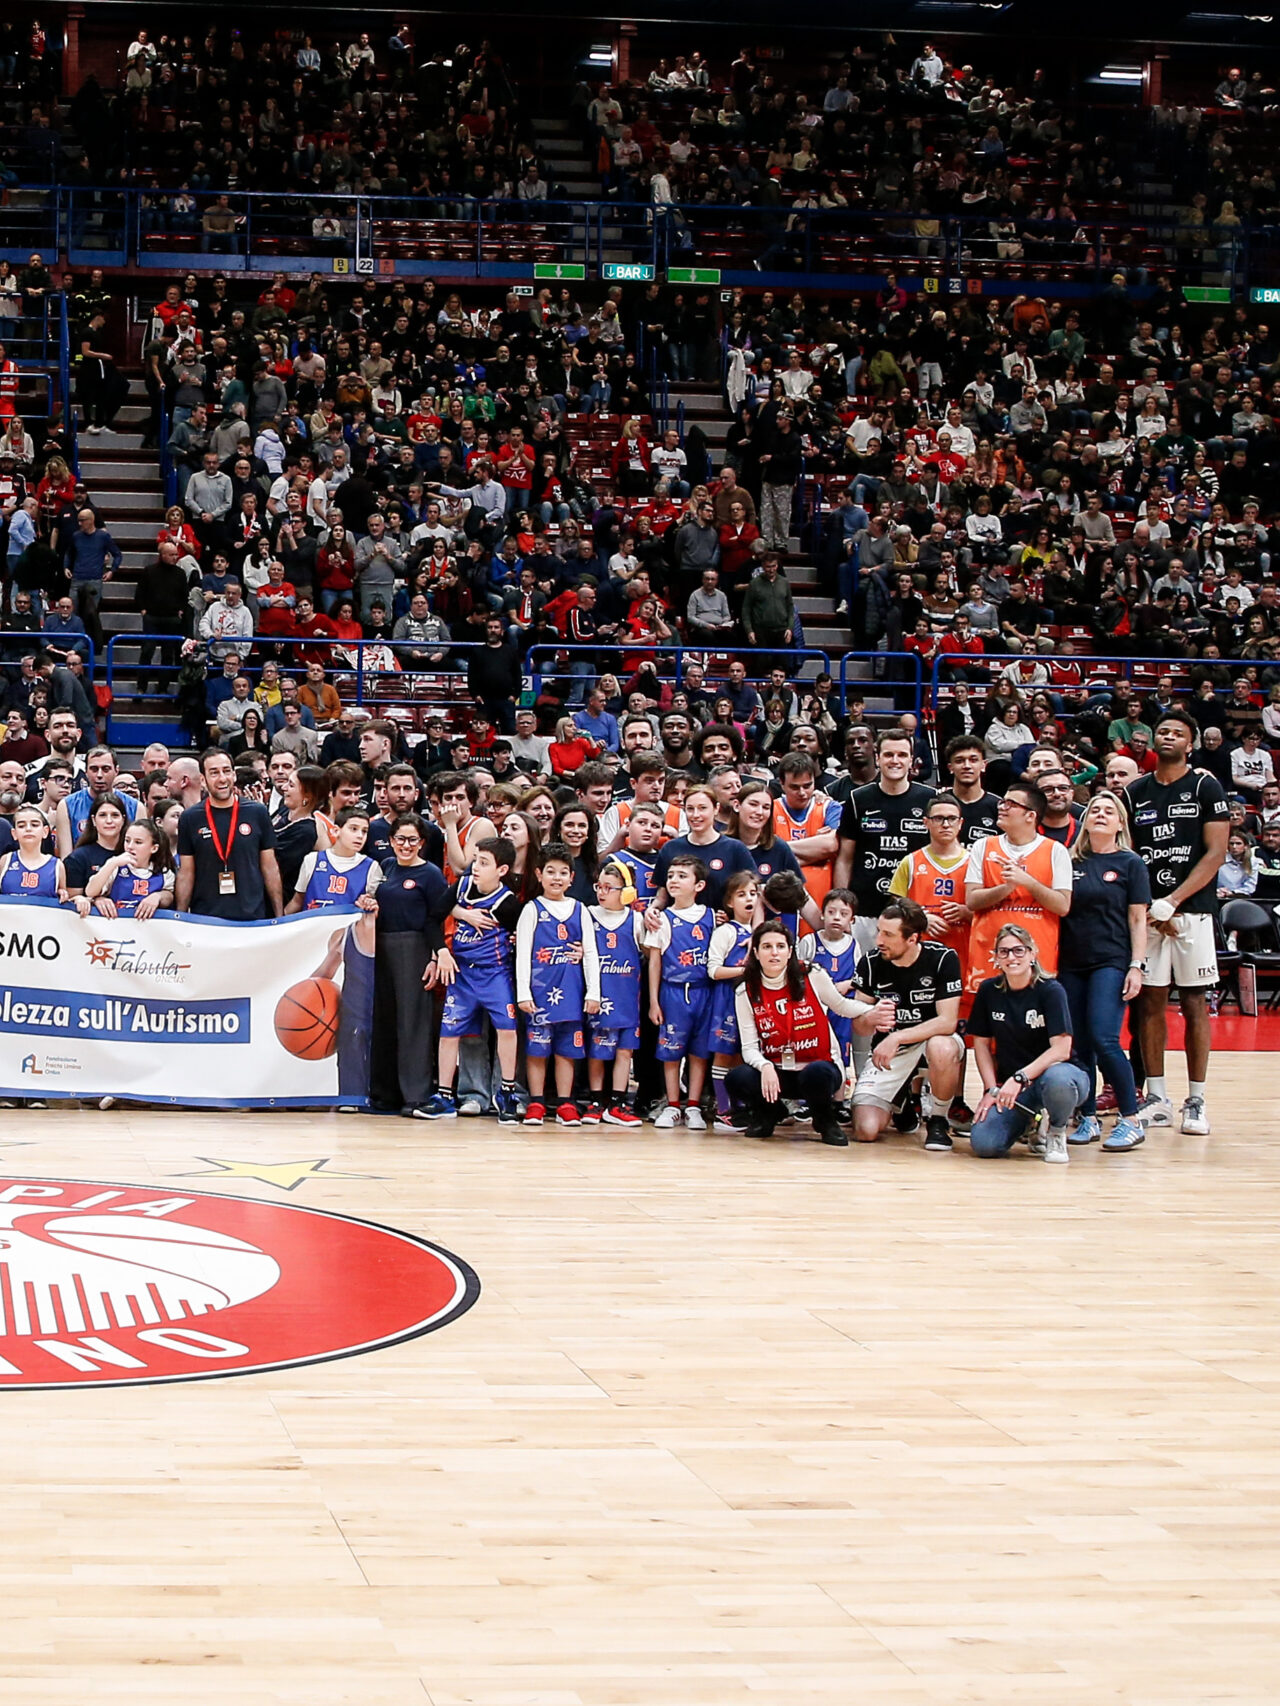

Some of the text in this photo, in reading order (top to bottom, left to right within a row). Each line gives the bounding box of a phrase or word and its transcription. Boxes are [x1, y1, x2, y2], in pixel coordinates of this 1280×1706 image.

[359, 260, 372, 270] 22
[616, 265, 642, 278] BAR
[1263, 290, 1280, 302] BA
[1213, 800, 1229, 812] ITA
[1152, 822, 1176, 838] ITAS
[879, 835, 908, 848] ITAS
[20, 872, 39, 888] 16
[132, 879, 149, 895] 12
[328, 875, 347, 894] 19
[933, 878, 955, 896] 29
[557, 923, 568, 941] 6
[691, 924, 704, 941] 4
[605, 932, 617, 949] 3
[103, 939, 181, 976] Fabula
[598, 954, 633, 975] Fabula
[831, 957, 839, 972] 1
[1197, 965, 1219, 978] ITAS
[78, 999, 240, 1034] sull'Autismo
[573, 1030, 584, 1048] 6
